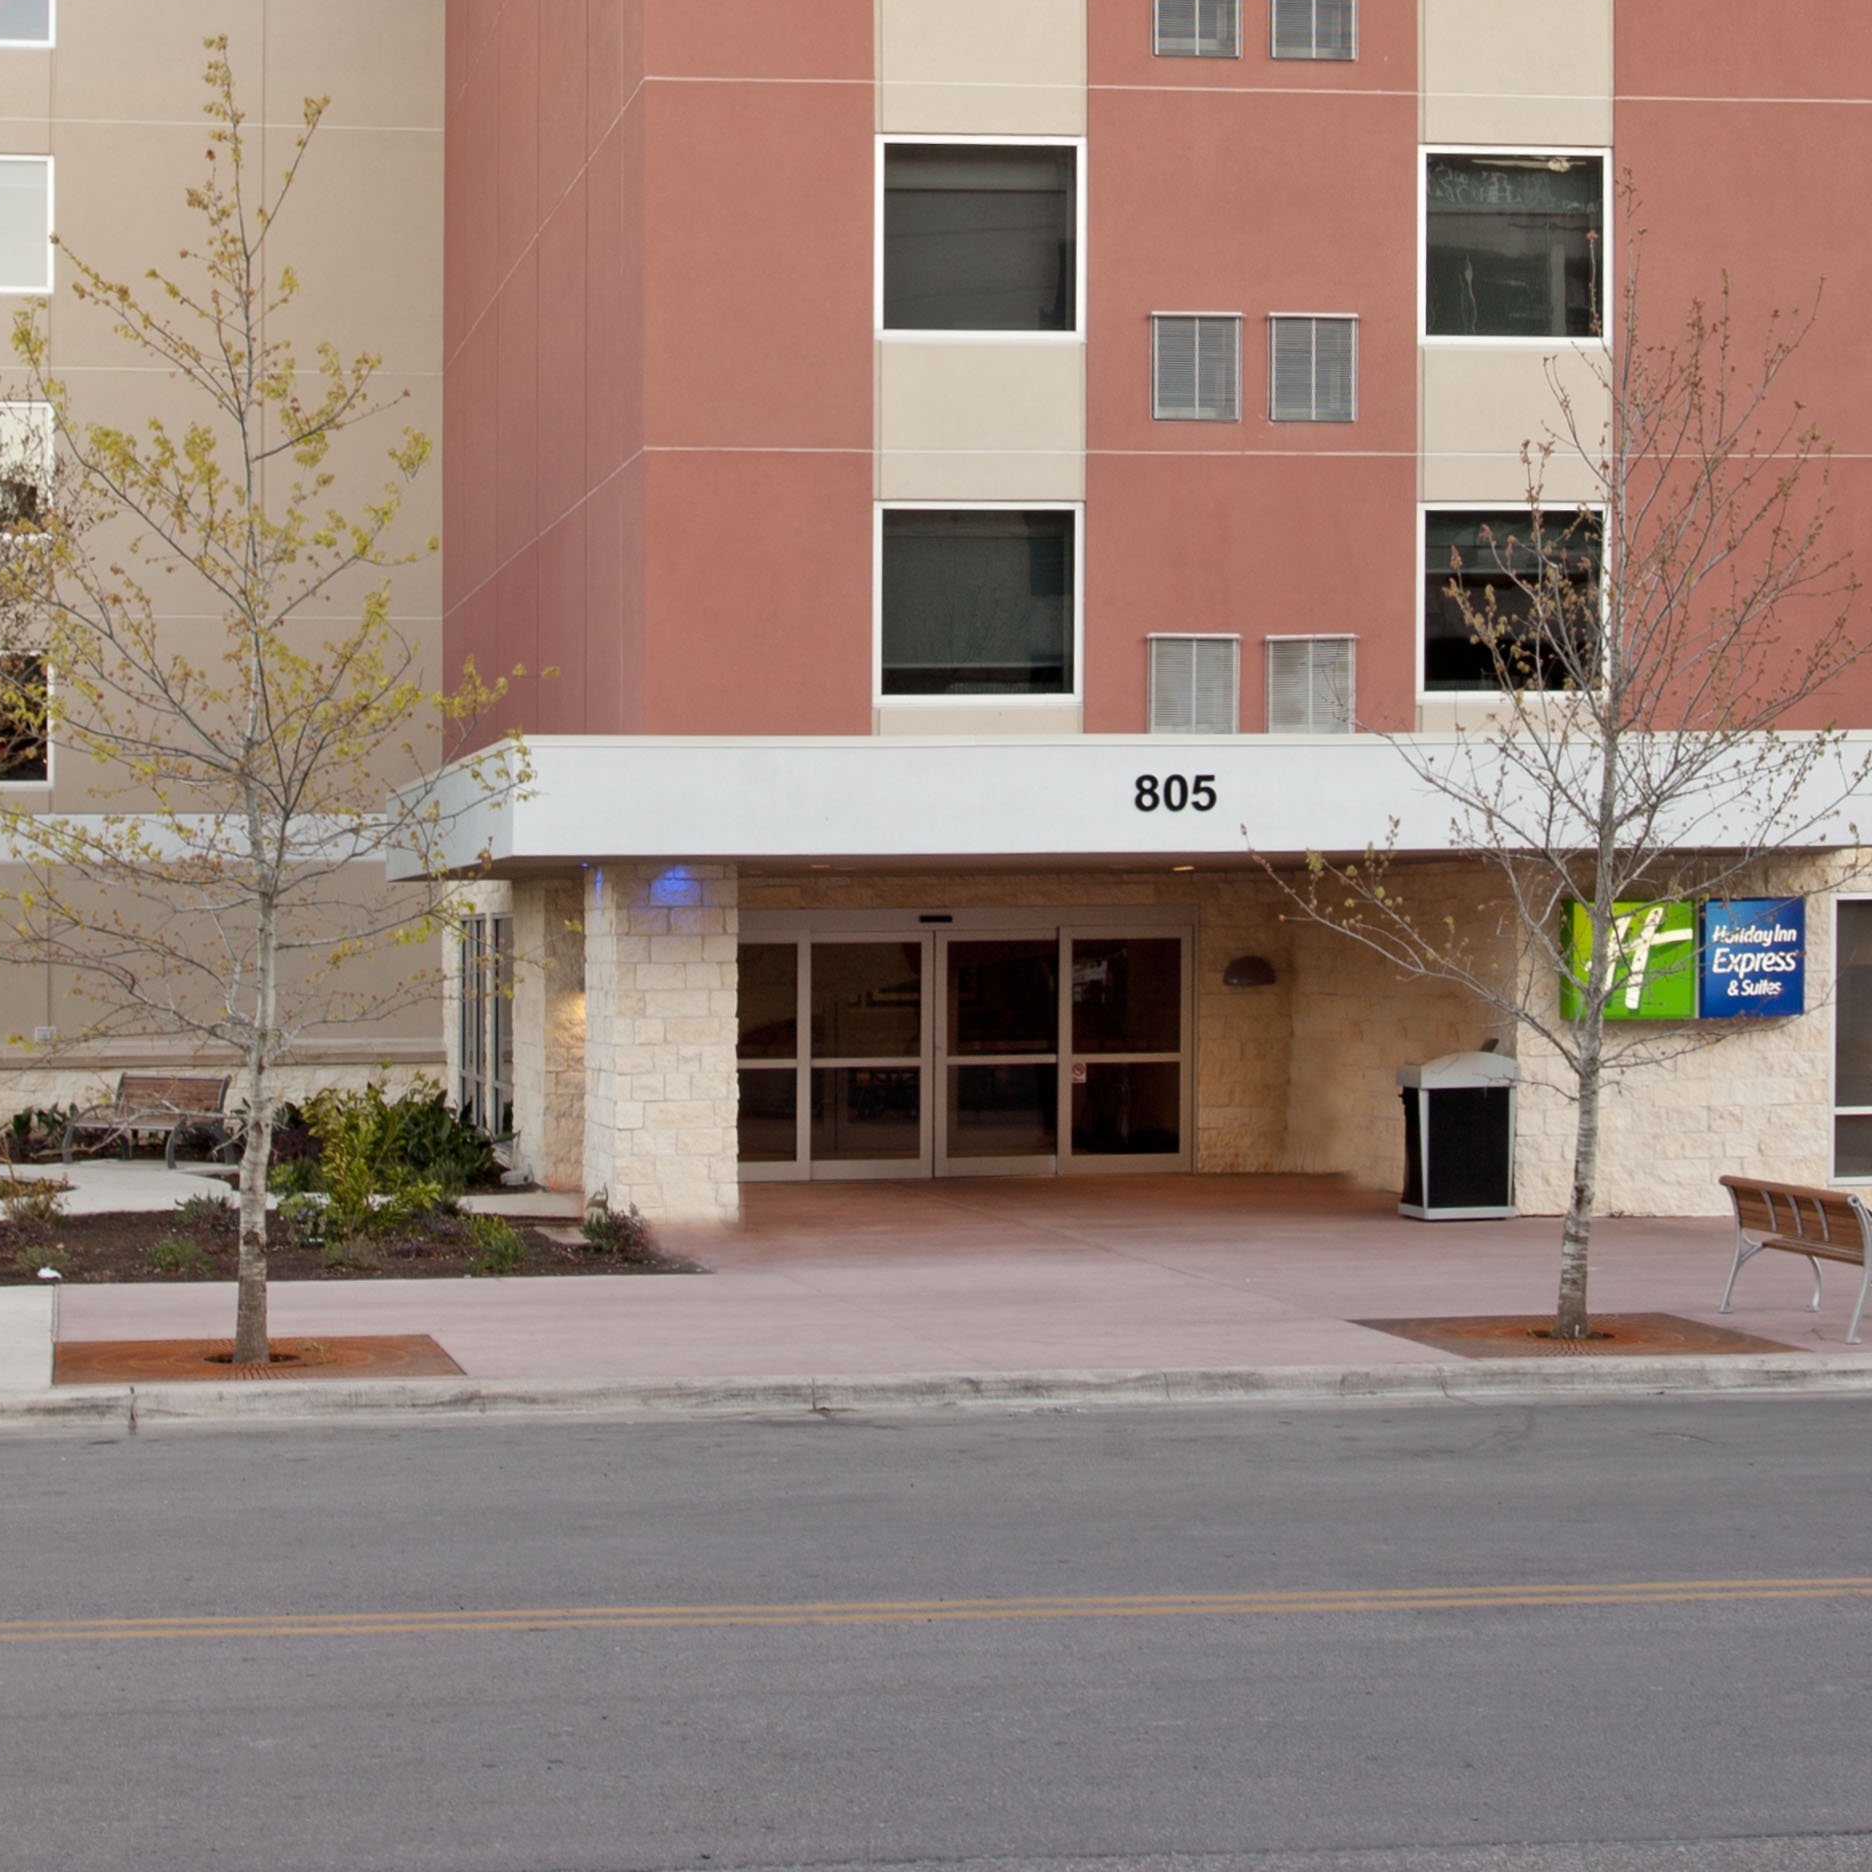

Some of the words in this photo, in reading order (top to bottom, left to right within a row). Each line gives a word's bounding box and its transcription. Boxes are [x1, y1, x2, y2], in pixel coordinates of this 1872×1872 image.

[1134, 774, 1217, 812] 805
[1712, 924, 1774, 947] Holiday
[1773, 923, 1797, 942] Inn
[1712, 947, 1797, 979] Express
[1727, 979, 1739, 997] &
[1741, 979, 1782, 996] Suites
